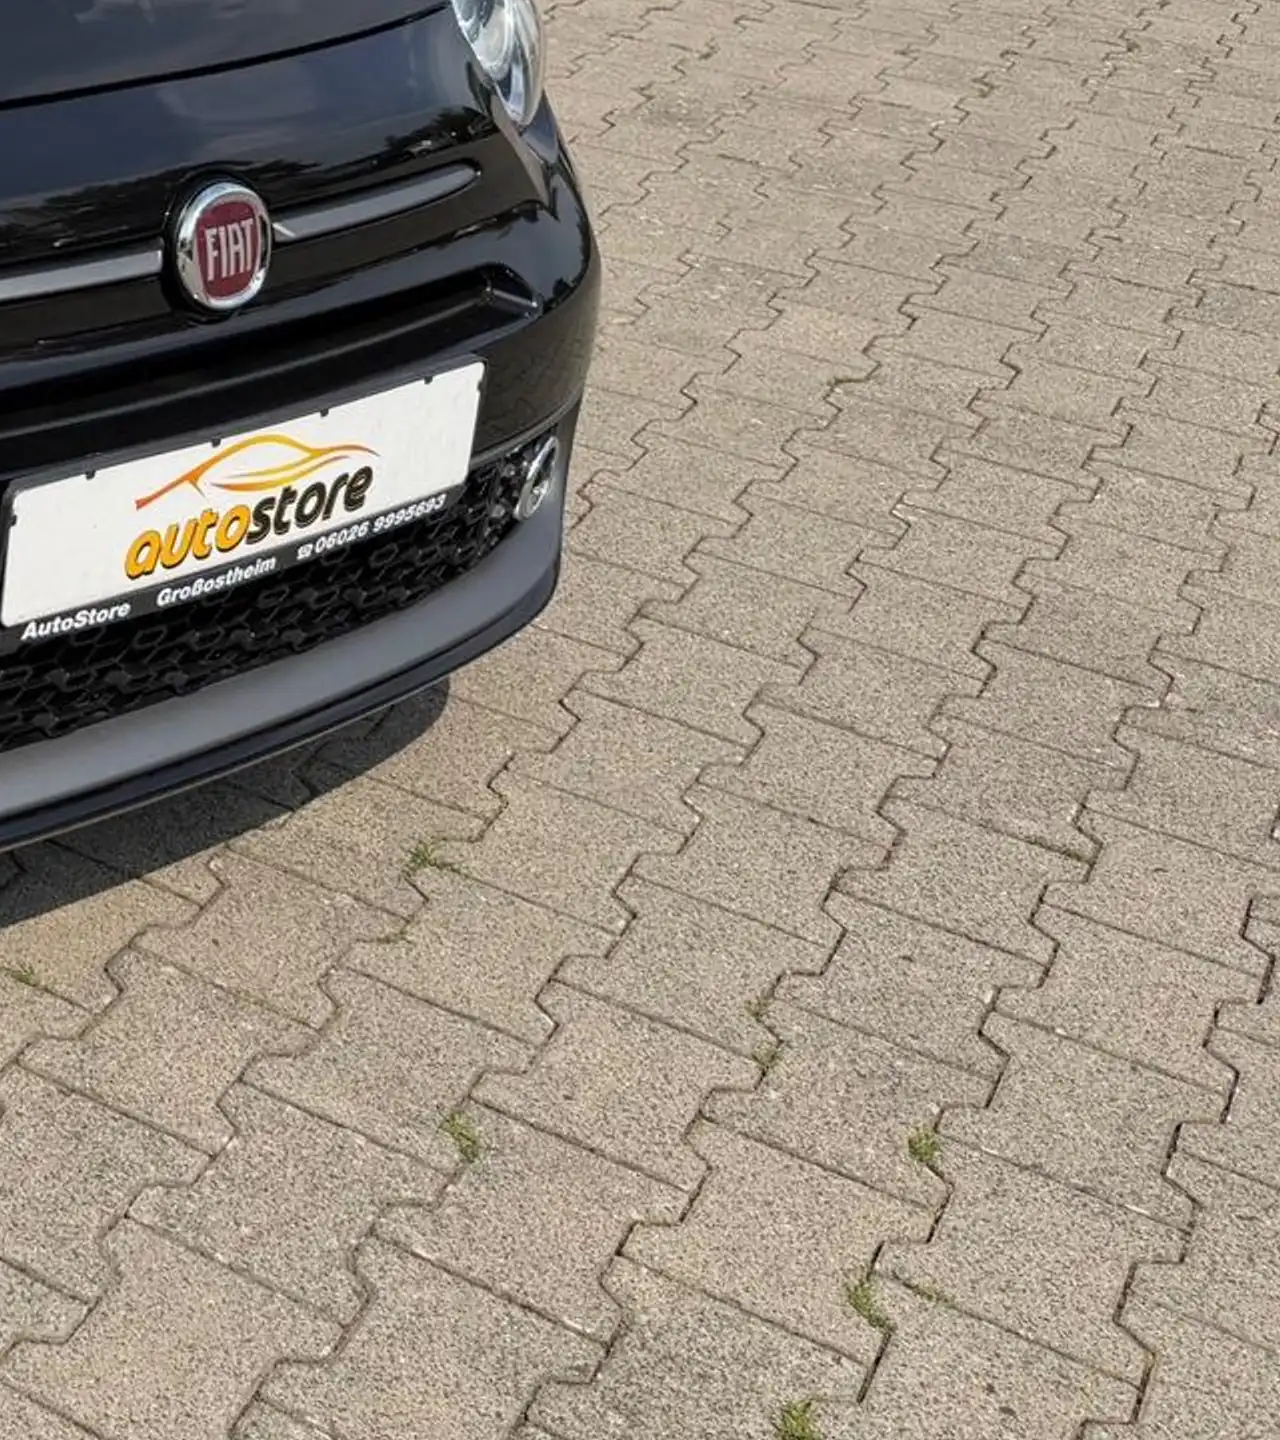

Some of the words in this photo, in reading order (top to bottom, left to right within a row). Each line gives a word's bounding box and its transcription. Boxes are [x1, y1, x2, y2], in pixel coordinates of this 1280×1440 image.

[204, 217, 254, 281] FIAT
[124, 462, 374, 579] autostore
[21, 601, 131, 641] AutoStore
